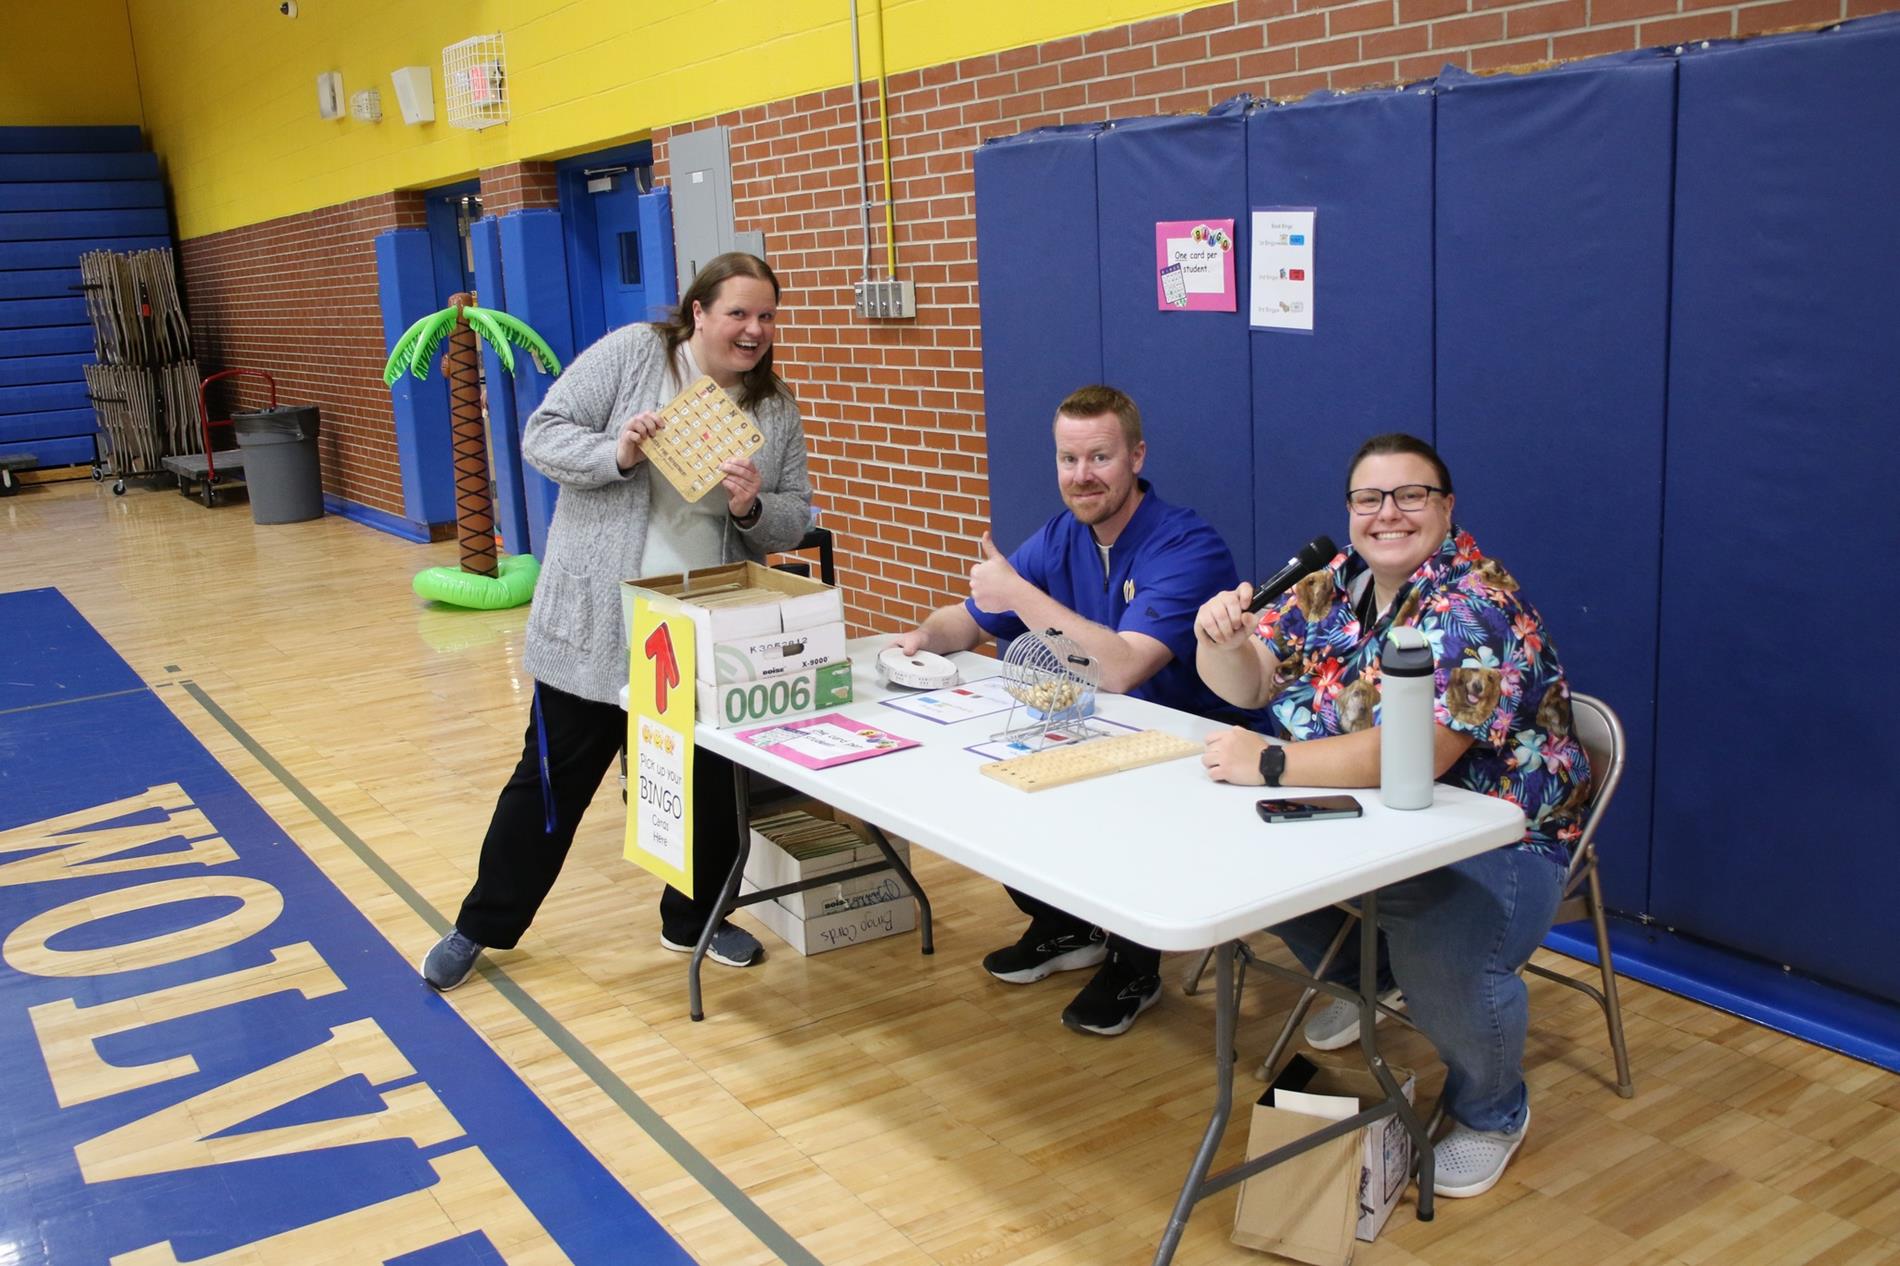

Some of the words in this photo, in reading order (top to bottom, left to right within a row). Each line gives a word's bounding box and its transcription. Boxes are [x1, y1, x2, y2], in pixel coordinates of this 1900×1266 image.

[1195, 230, 1228, 249] BINGO
[1174, 251, 1188, 260] One
[1190, 251, 1205, 259] card
[1206, 252, 1218, 261] per
[725, 676, 811, 723] 0006
[640, 753, 655, 770] Pick
[657, 765, 666, 777] up
[667, 769, 681, 784] your
[640, 775, 682, 820] BINGO
[653, 832, 668, 847] Here
[820, 925, 857, 945] Cards
